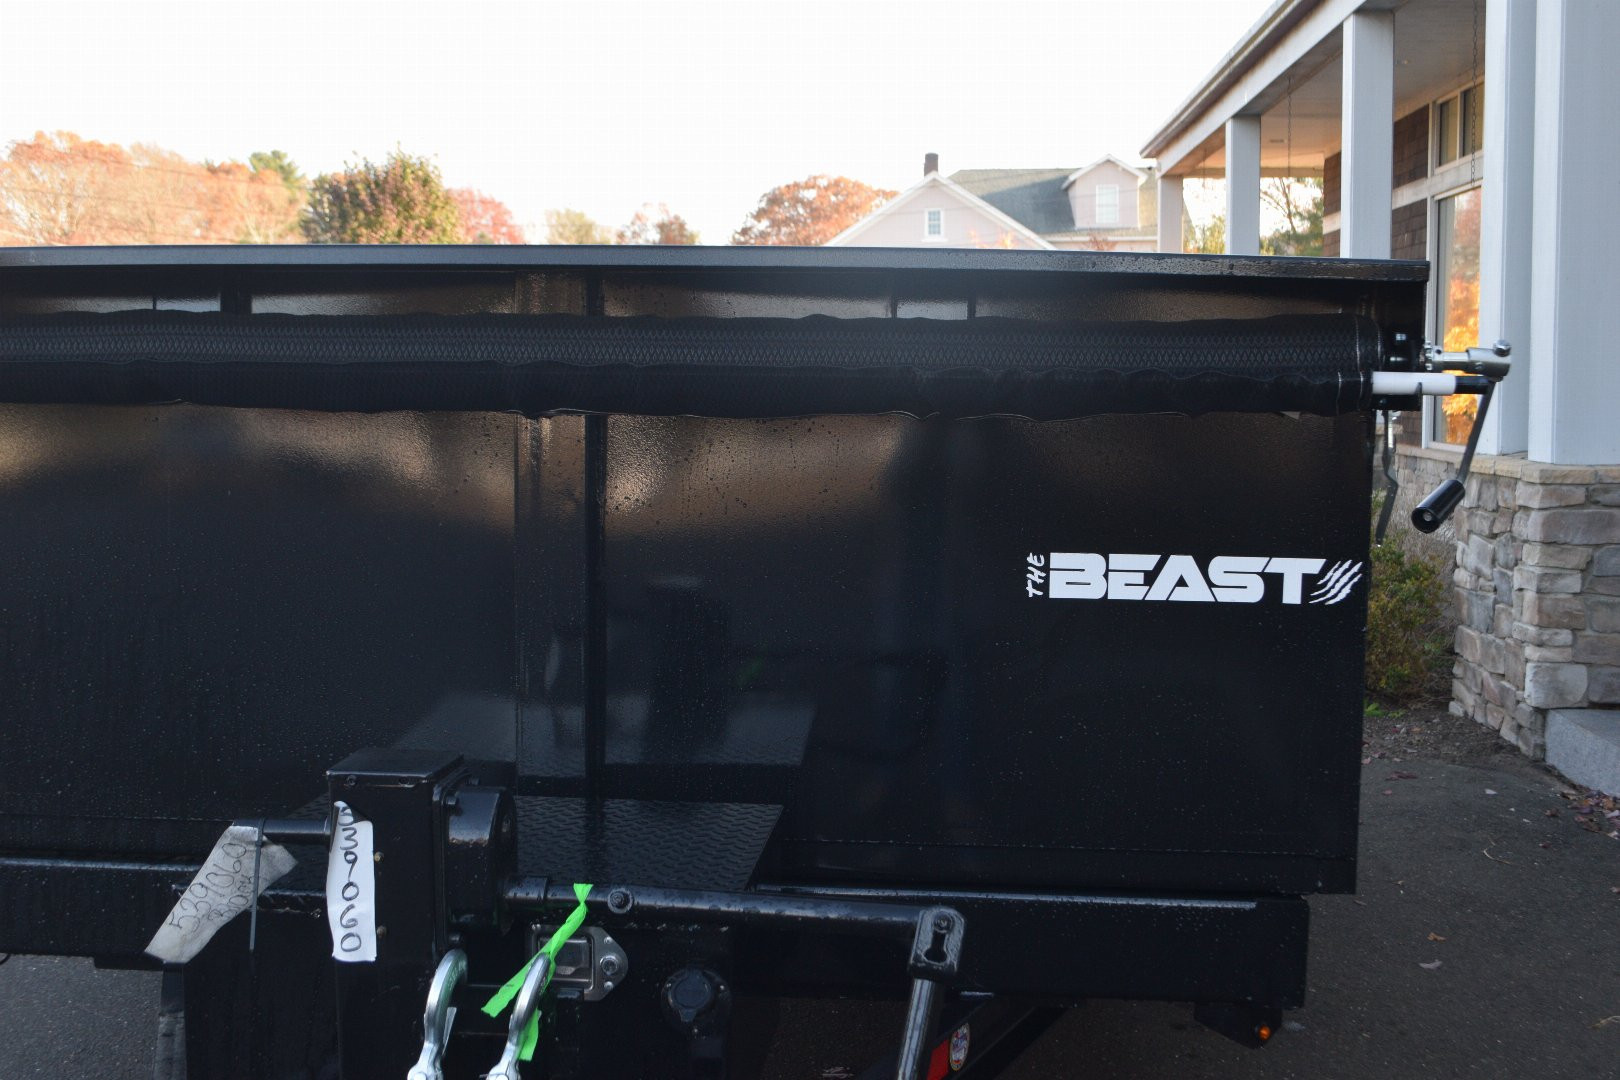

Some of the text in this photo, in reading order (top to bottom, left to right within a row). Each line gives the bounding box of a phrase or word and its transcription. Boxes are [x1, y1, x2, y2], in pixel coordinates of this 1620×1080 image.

[1026, 552, 1045, 598] THE
[1049, 552, 1326, 604] BEAST
[168, 841, 247, 937] 539060
